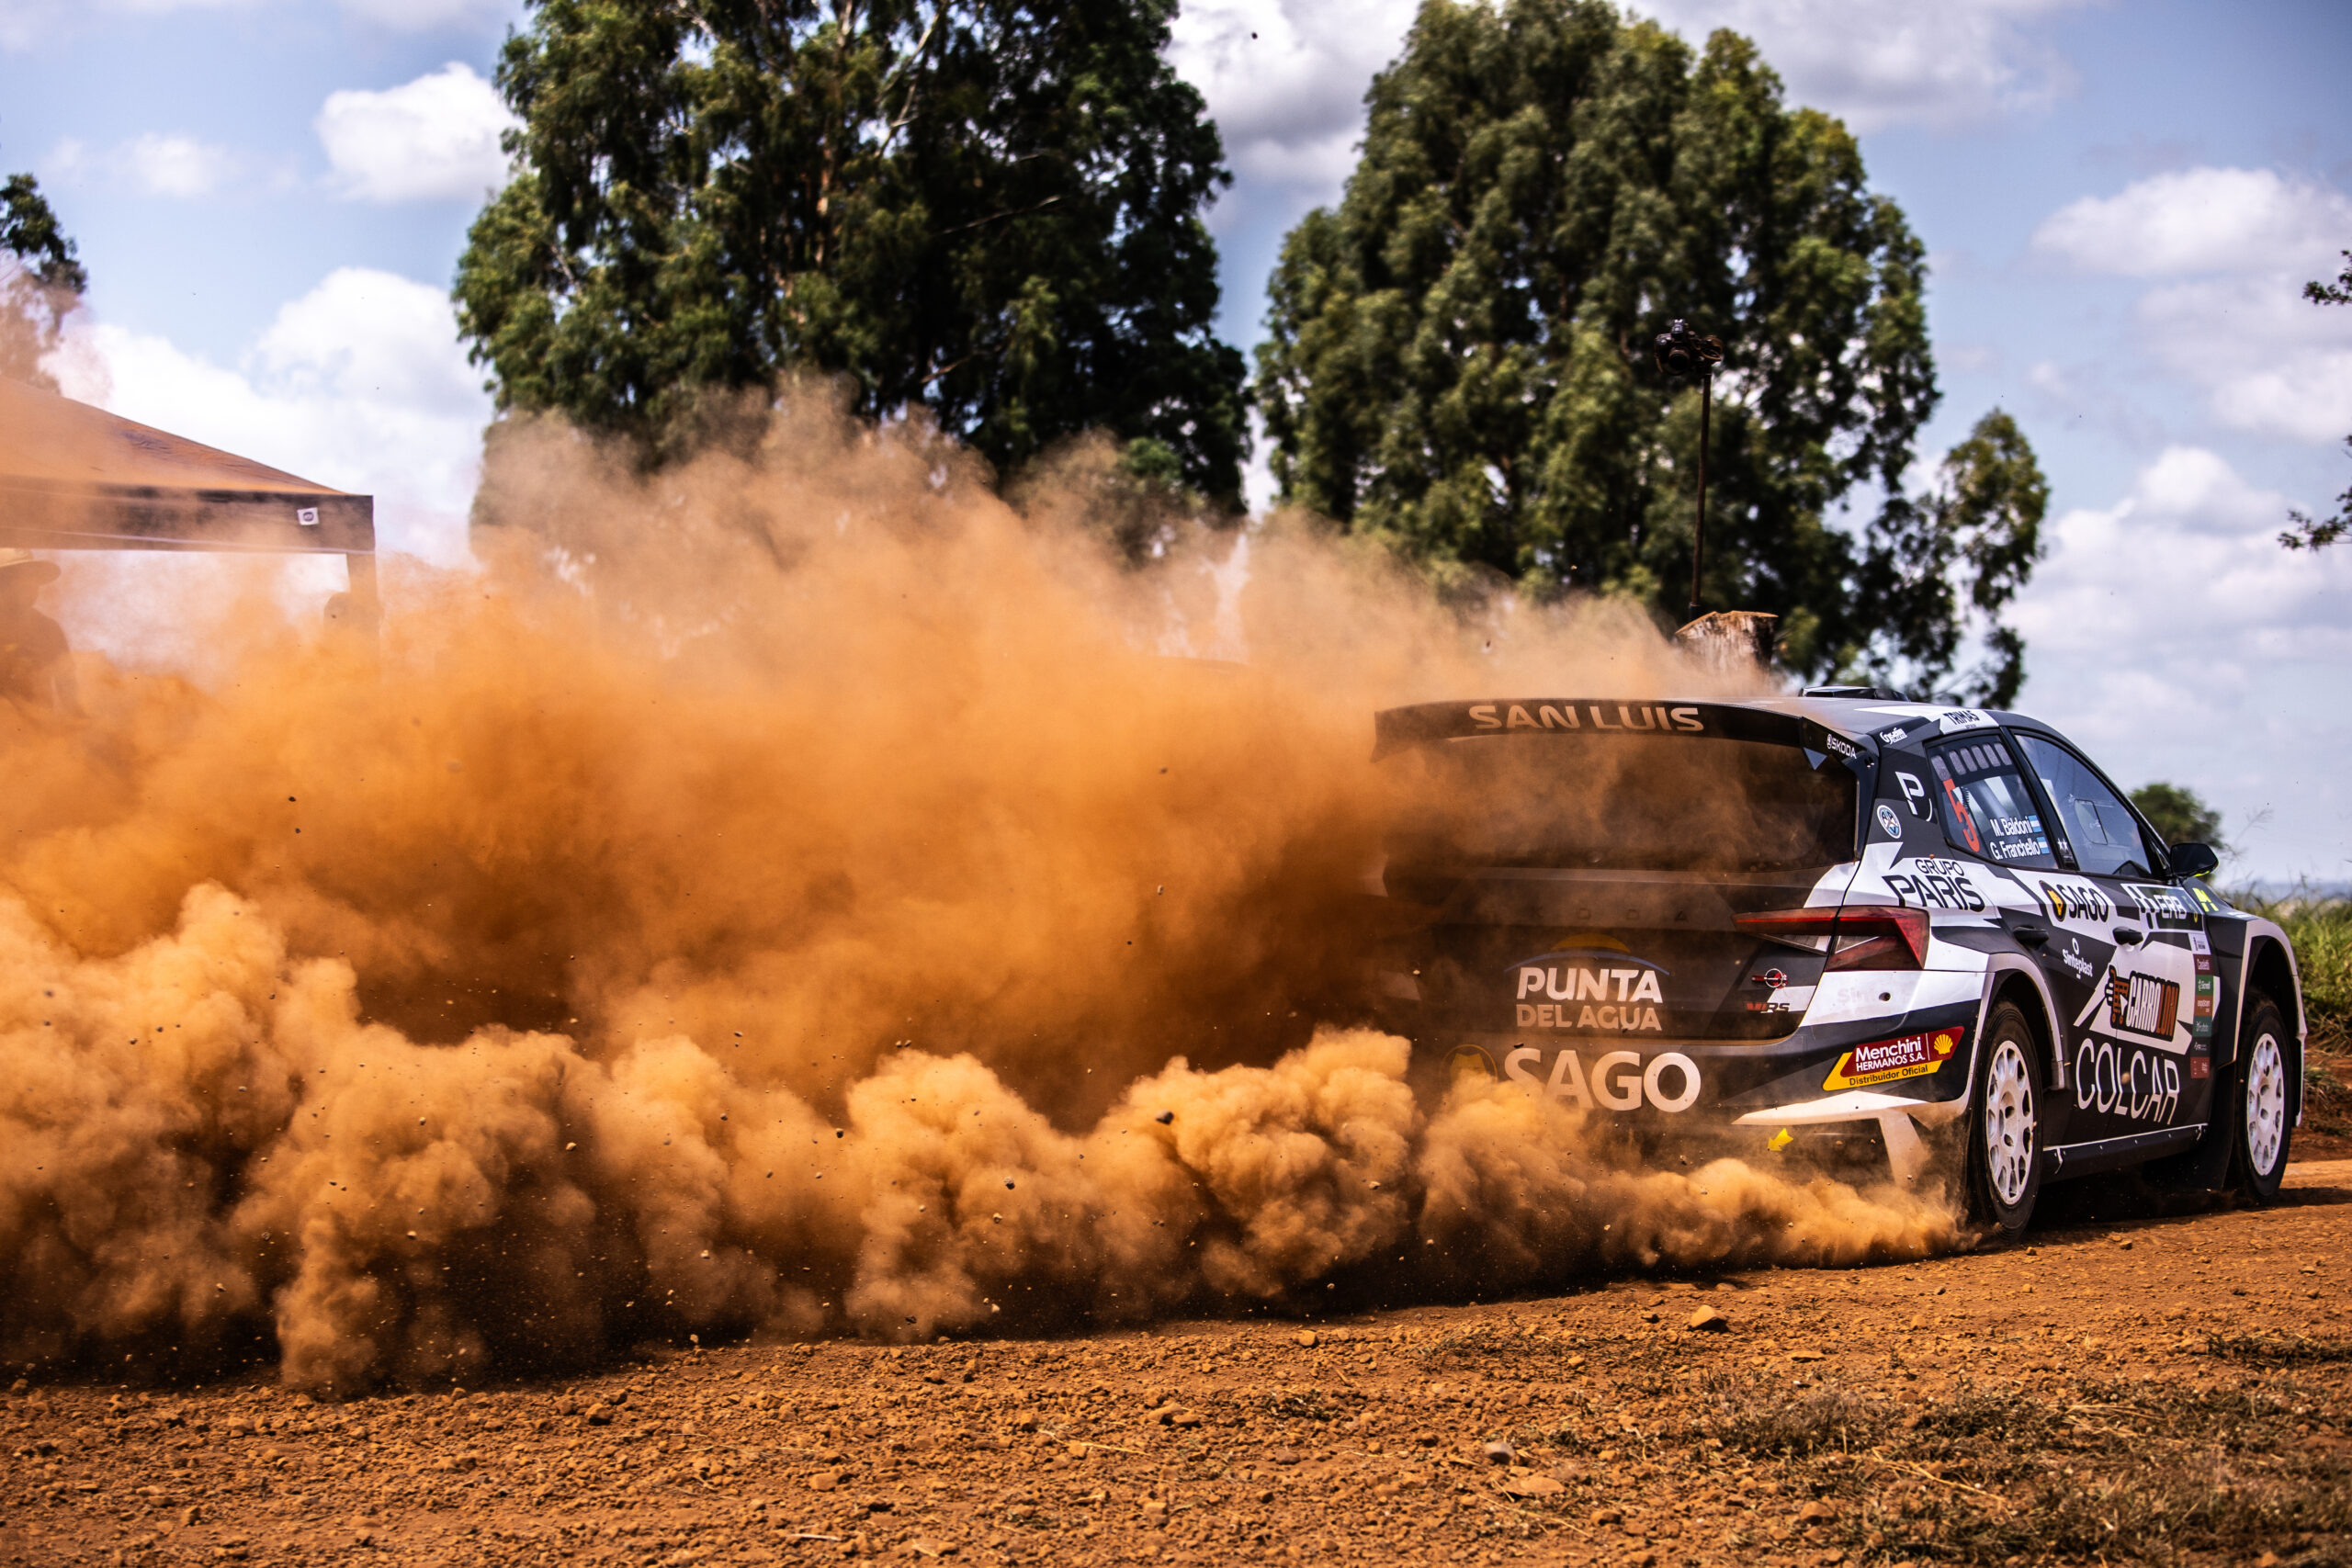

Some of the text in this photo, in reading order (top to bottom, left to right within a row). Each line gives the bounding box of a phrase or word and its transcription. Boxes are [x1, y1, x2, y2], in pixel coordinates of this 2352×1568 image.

[1469, 705, 1704, 731] SAN LUIS
[1942, 710, 1980, 725] TRIMAS
[1942, 778, 1980, 852] 5
[1990, 816, 2033, 837] M. Baldoni
[1990, 838, 2041, 860] G. Franchello
[1915, 859, 1965, 876] GRUPO
[1882, 874, 1985, 912] PARIS
[2056, 884, 2109, 922] SAGO
[2062, 949, 2093, 977] Sinteplast
[1516, 967, 1664, 1003] PUNTA
[1516, 1004, 1663, 1032] DEL AGUA
[2125, 976, 2180, 1037] CARROLON
[1855, 1036, 1922, 1063] Menchini
[1856, 1053, 1926, 1072] HERMANOS S.A.
[1504, 1047, 1702, 1112] SAGO
[1849, 1065, 1928, 1086] Distribuidor Oficial
[2075, 1037, 2180, 1125] COLCAR
